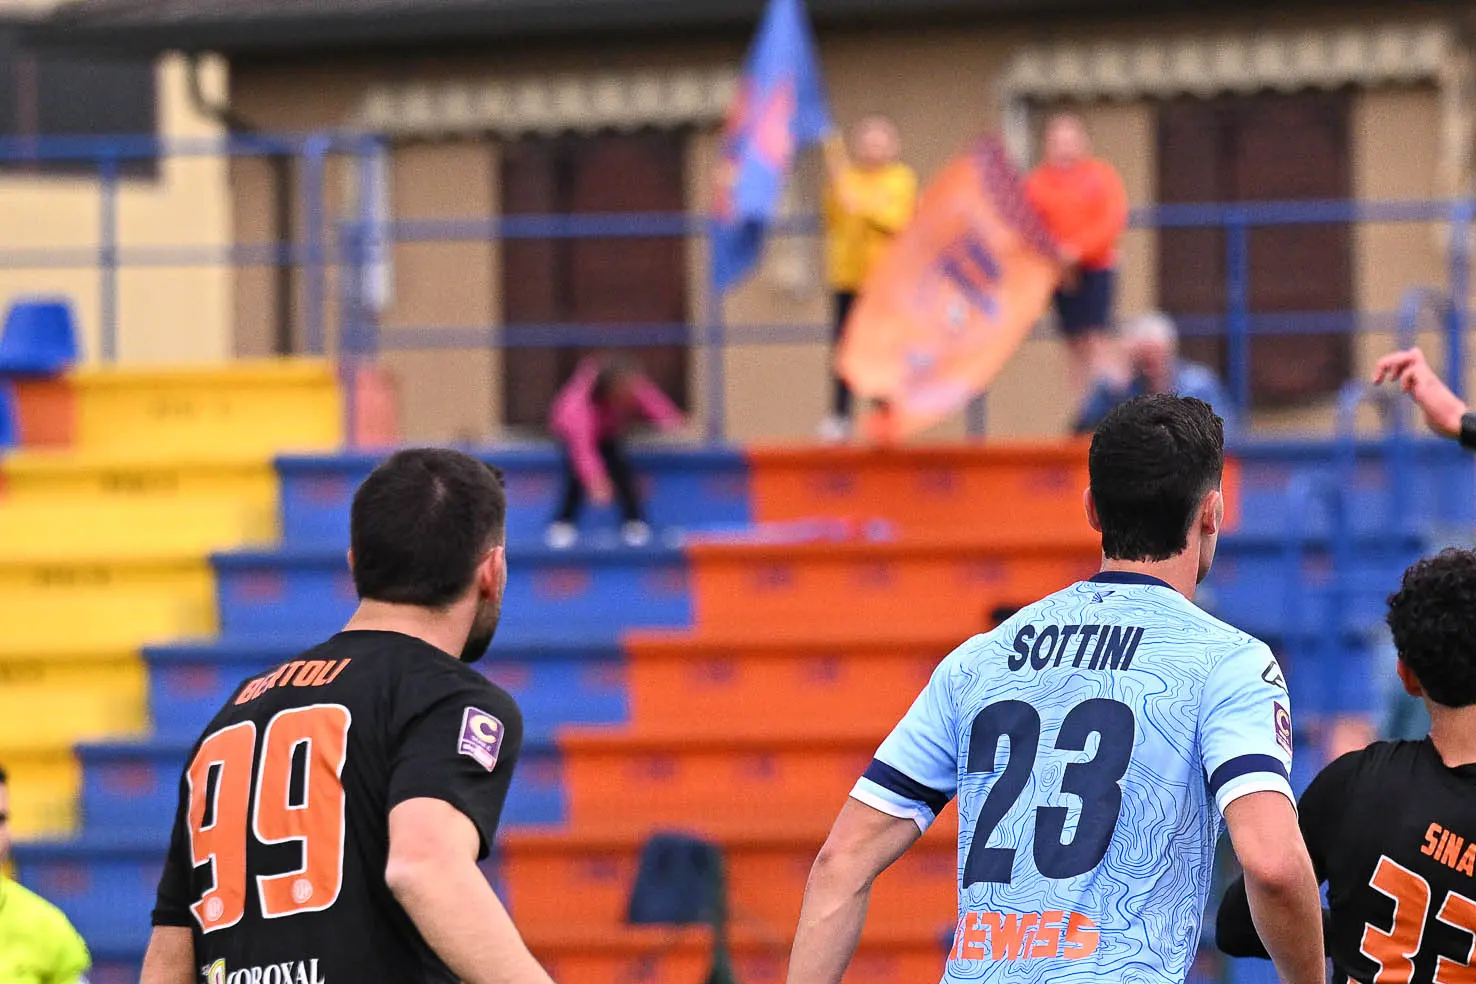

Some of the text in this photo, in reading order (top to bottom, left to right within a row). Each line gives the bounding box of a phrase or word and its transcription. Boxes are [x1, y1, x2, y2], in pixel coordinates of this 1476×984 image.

[1007, 624, 1145, 671] SOTTINI
[186, 703, 352, 934] 99
[962, 697, 1136, 889] 23
